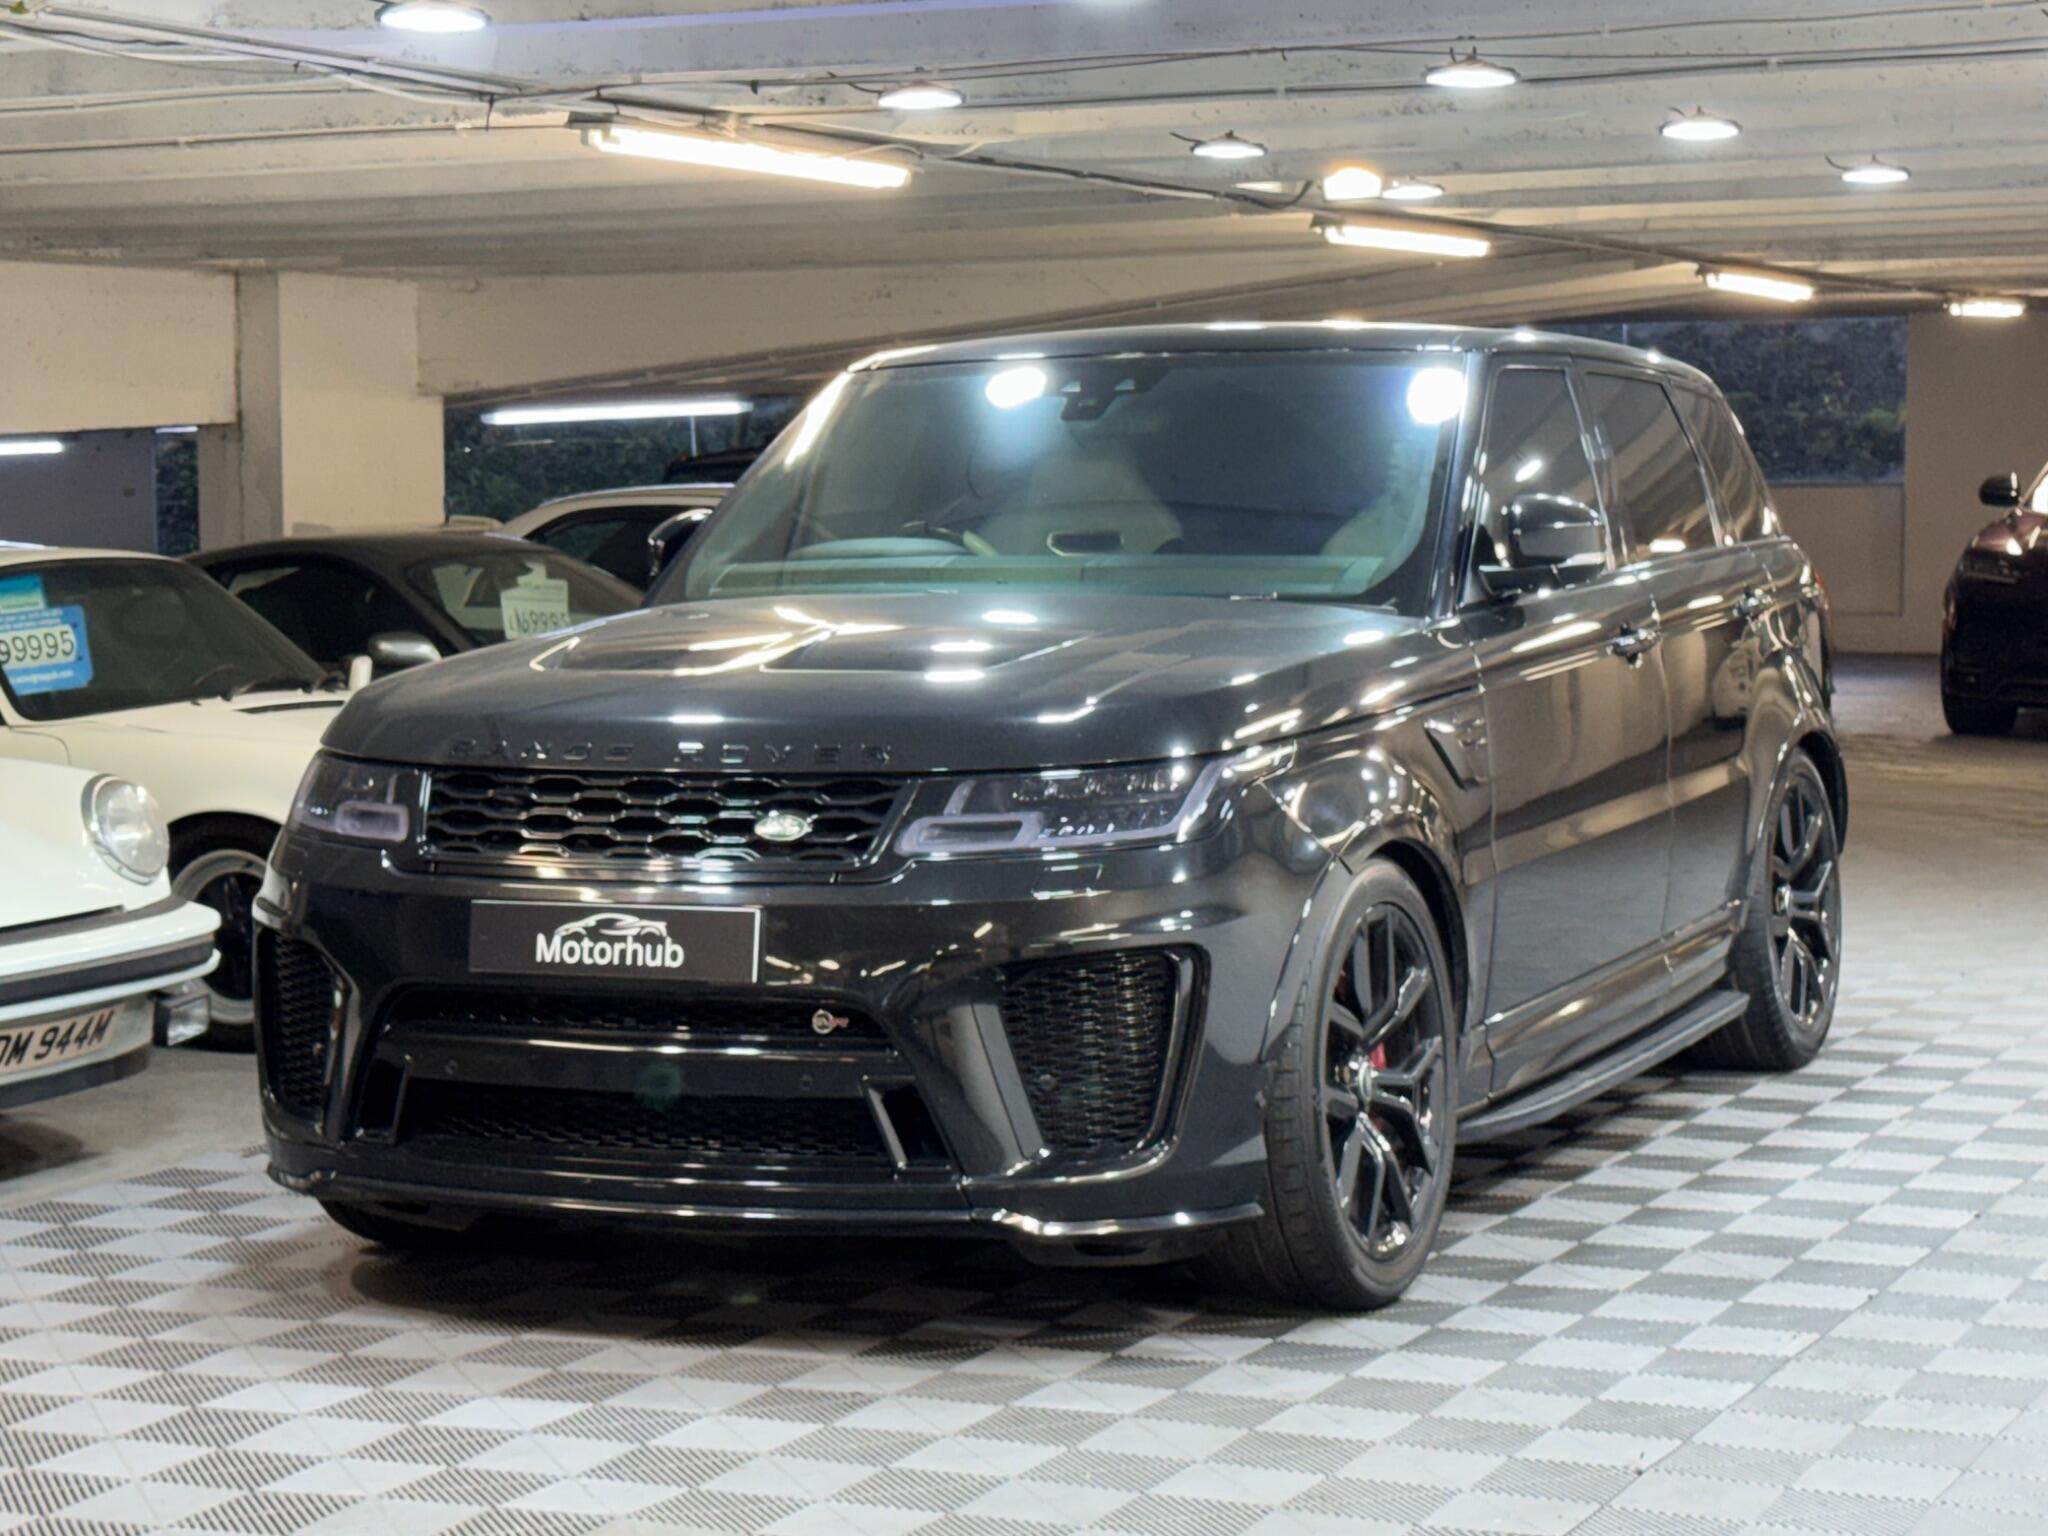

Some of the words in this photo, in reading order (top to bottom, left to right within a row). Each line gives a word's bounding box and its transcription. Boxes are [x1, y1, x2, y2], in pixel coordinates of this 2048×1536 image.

[449, 740, 635, 762] RANGE
[673, 741, 892, 764] ROVER
[535, 932, 685, 968] Motorhub
